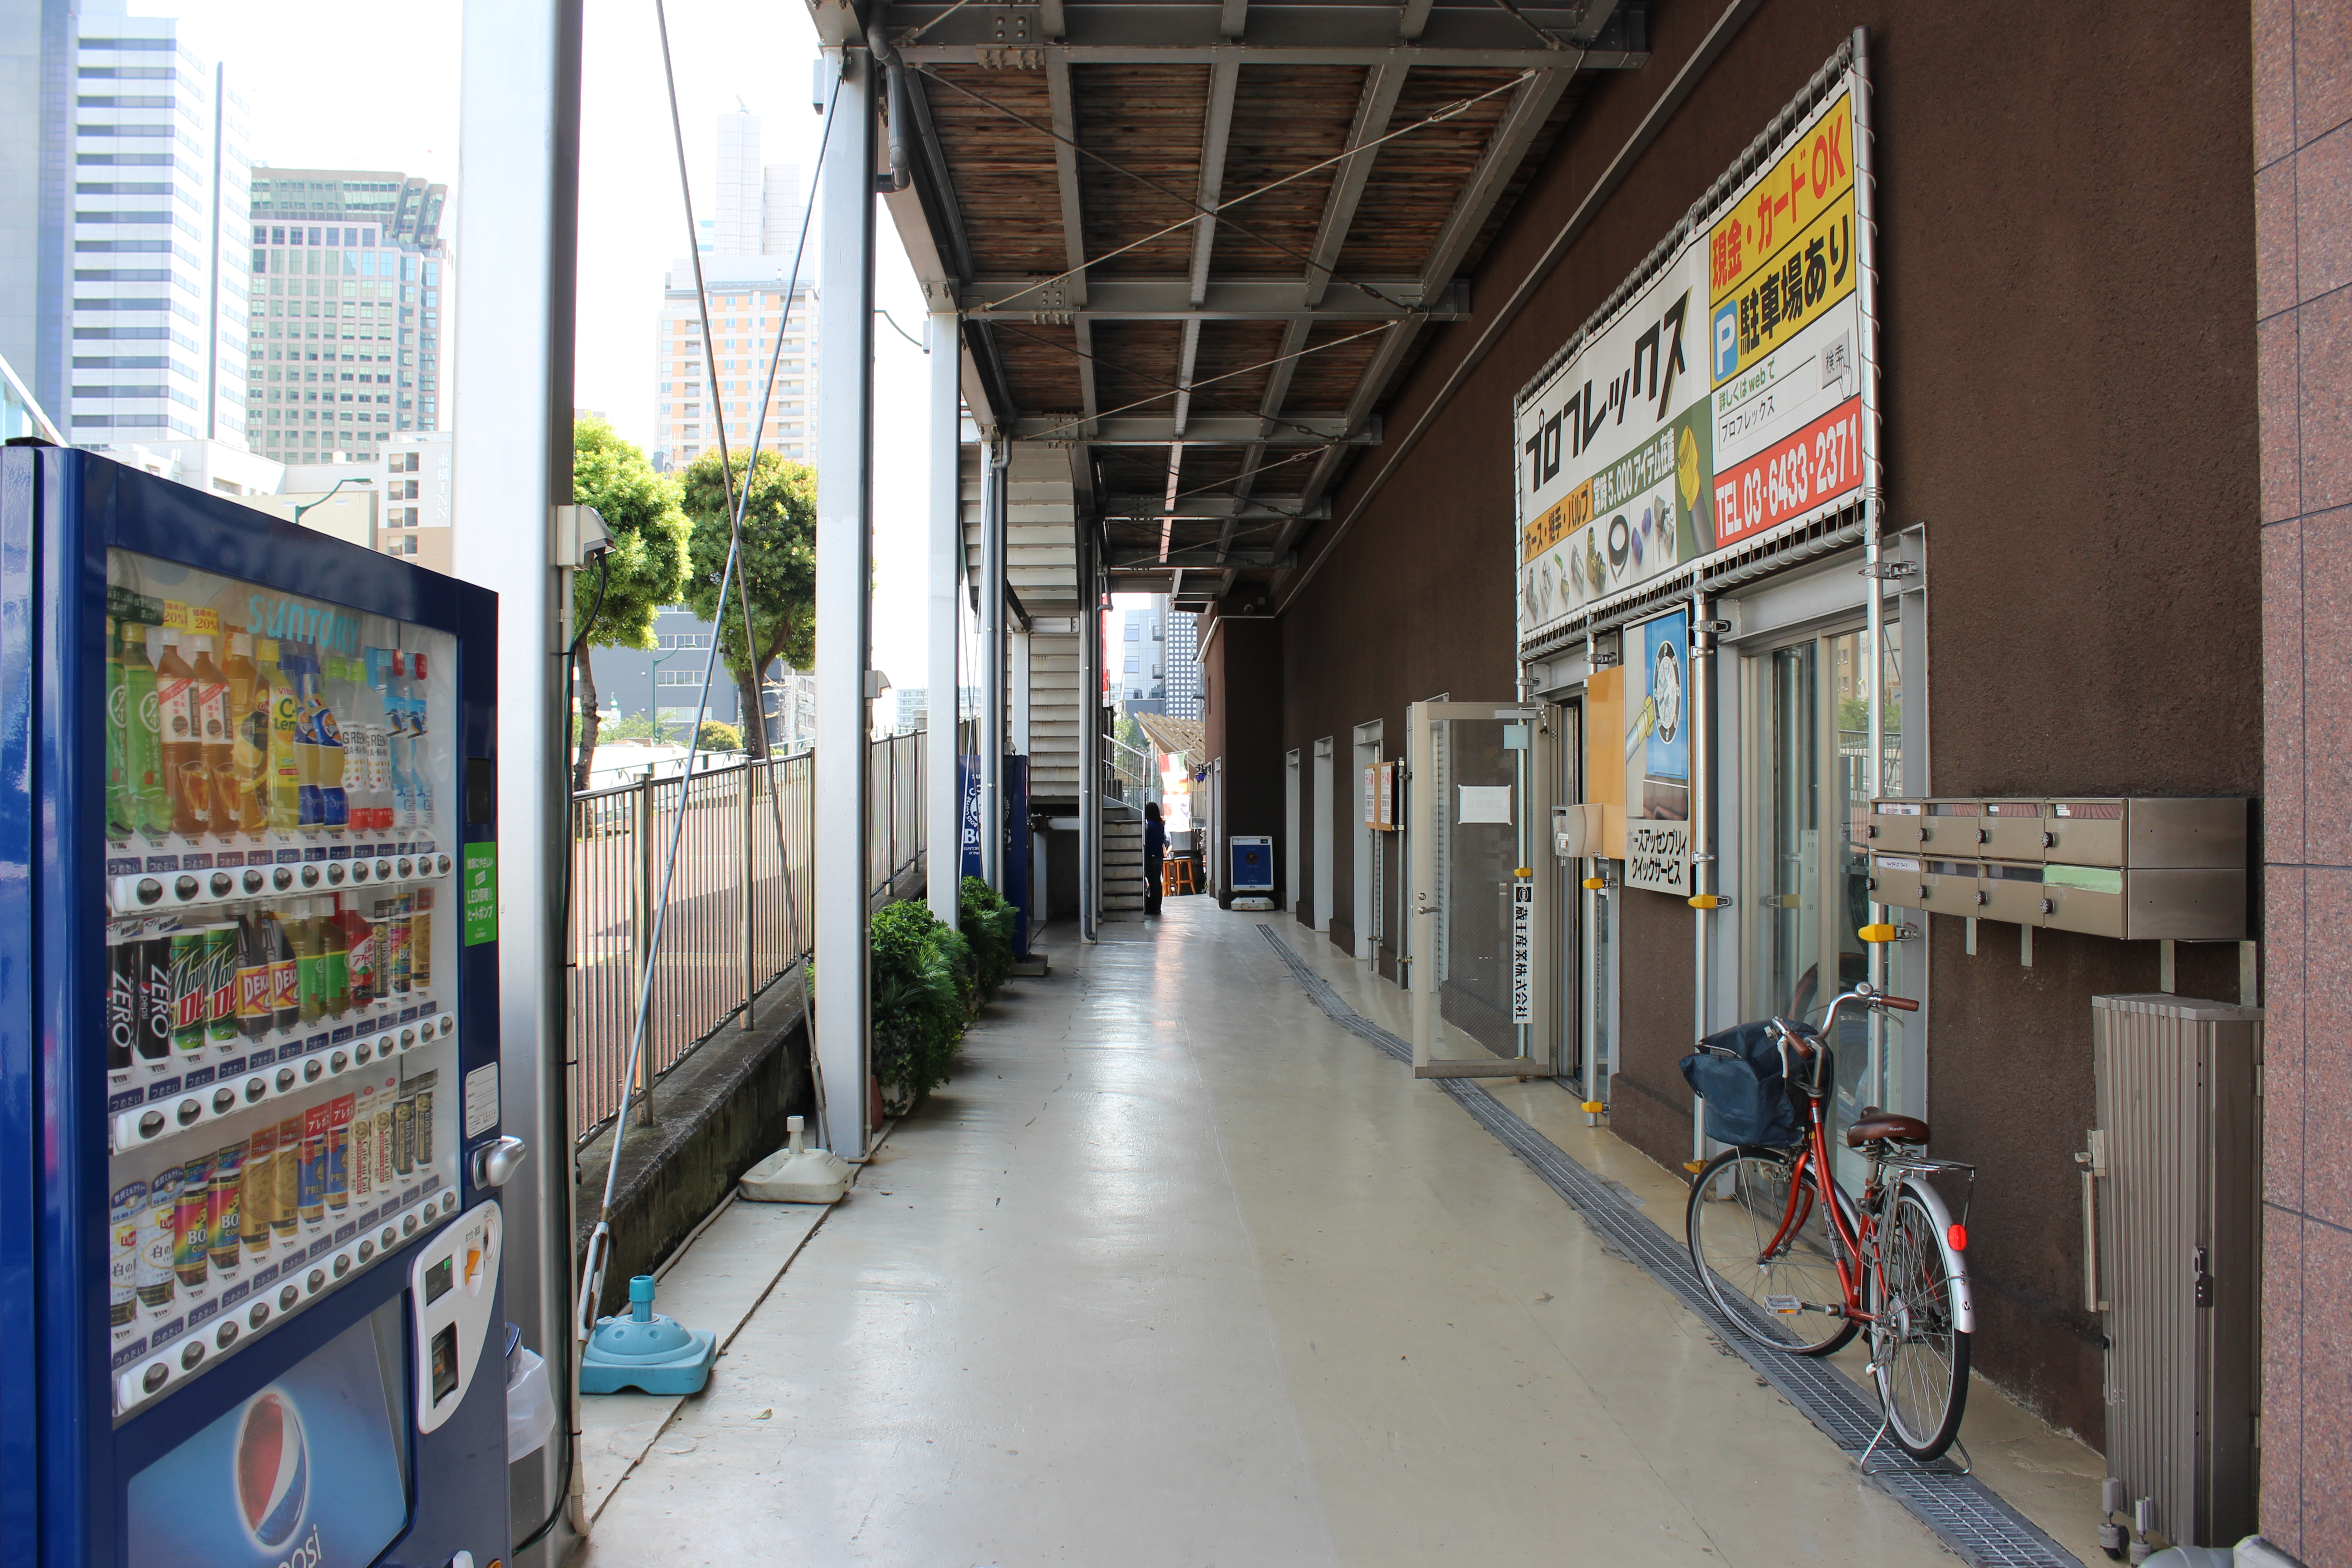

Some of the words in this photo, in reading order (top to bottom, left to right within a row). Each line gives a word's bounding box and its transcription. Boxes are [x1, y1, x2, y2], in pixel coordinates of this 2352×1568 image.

[1713, 113, 1846, 291] 現金・カードOK
[1740, 213, 1848, 358] 駐車場あり
[1525, 285, 1692, 494] プロフレックス
[1721, 395, 1775, 443] プロフレックス
[1715, 480, 1743, 539] TEL
[1743, 413, 1858, 529] 03-6433-2371
[436, 454, 451, 519] 東横INN
[186, 859, 211, 869] つめたい
[219, 857, 242, 867] つめたい
[250, 855, 271, 864] つめたい
[278, 853, 299, 862] つめたい
[110, 863, 140, 874] つめたい
[150, 862, 177, 872] つめたい
[1632, 855, 1681, 886] クイックサービス
[1515, 905, 1528, 1020] 蔵王産業株式会社
[151, 964, 169, 1039] ZERO
[112, 970, 132, 1048] ZERO
[333, 1031, 352, 1043] つめたい
[308, 1039, 328, 1050] つめたい
[281, 1046, 301, 1058] つめたい
[252, 1055, 274, 1067] つめたい
[221, 1063, 245, 1076] つめたい
[187, 1073, 213, 1086] つめたい
[152, 1084, 178, 1098] つめたい
[112, 1095, 141, 1109] つめたい
[336, 1226, 355, 1241] つめたい
[151, 1241, 175, 1259] 白の
[311, 1240, 331, 1254] つめたい
[284, 1253, 304, 1267] つめたい
[112, 1259, 137, 1277] 白の
[255, 1271, 277, 1286] つめたい
[224, 1288, 247, 1302] つめたい
[191, 1306, 216, 1322] つめたい
[154, 1325, 181, 1341] つめたい
[114, 1345, 144, 1366] つめたい
